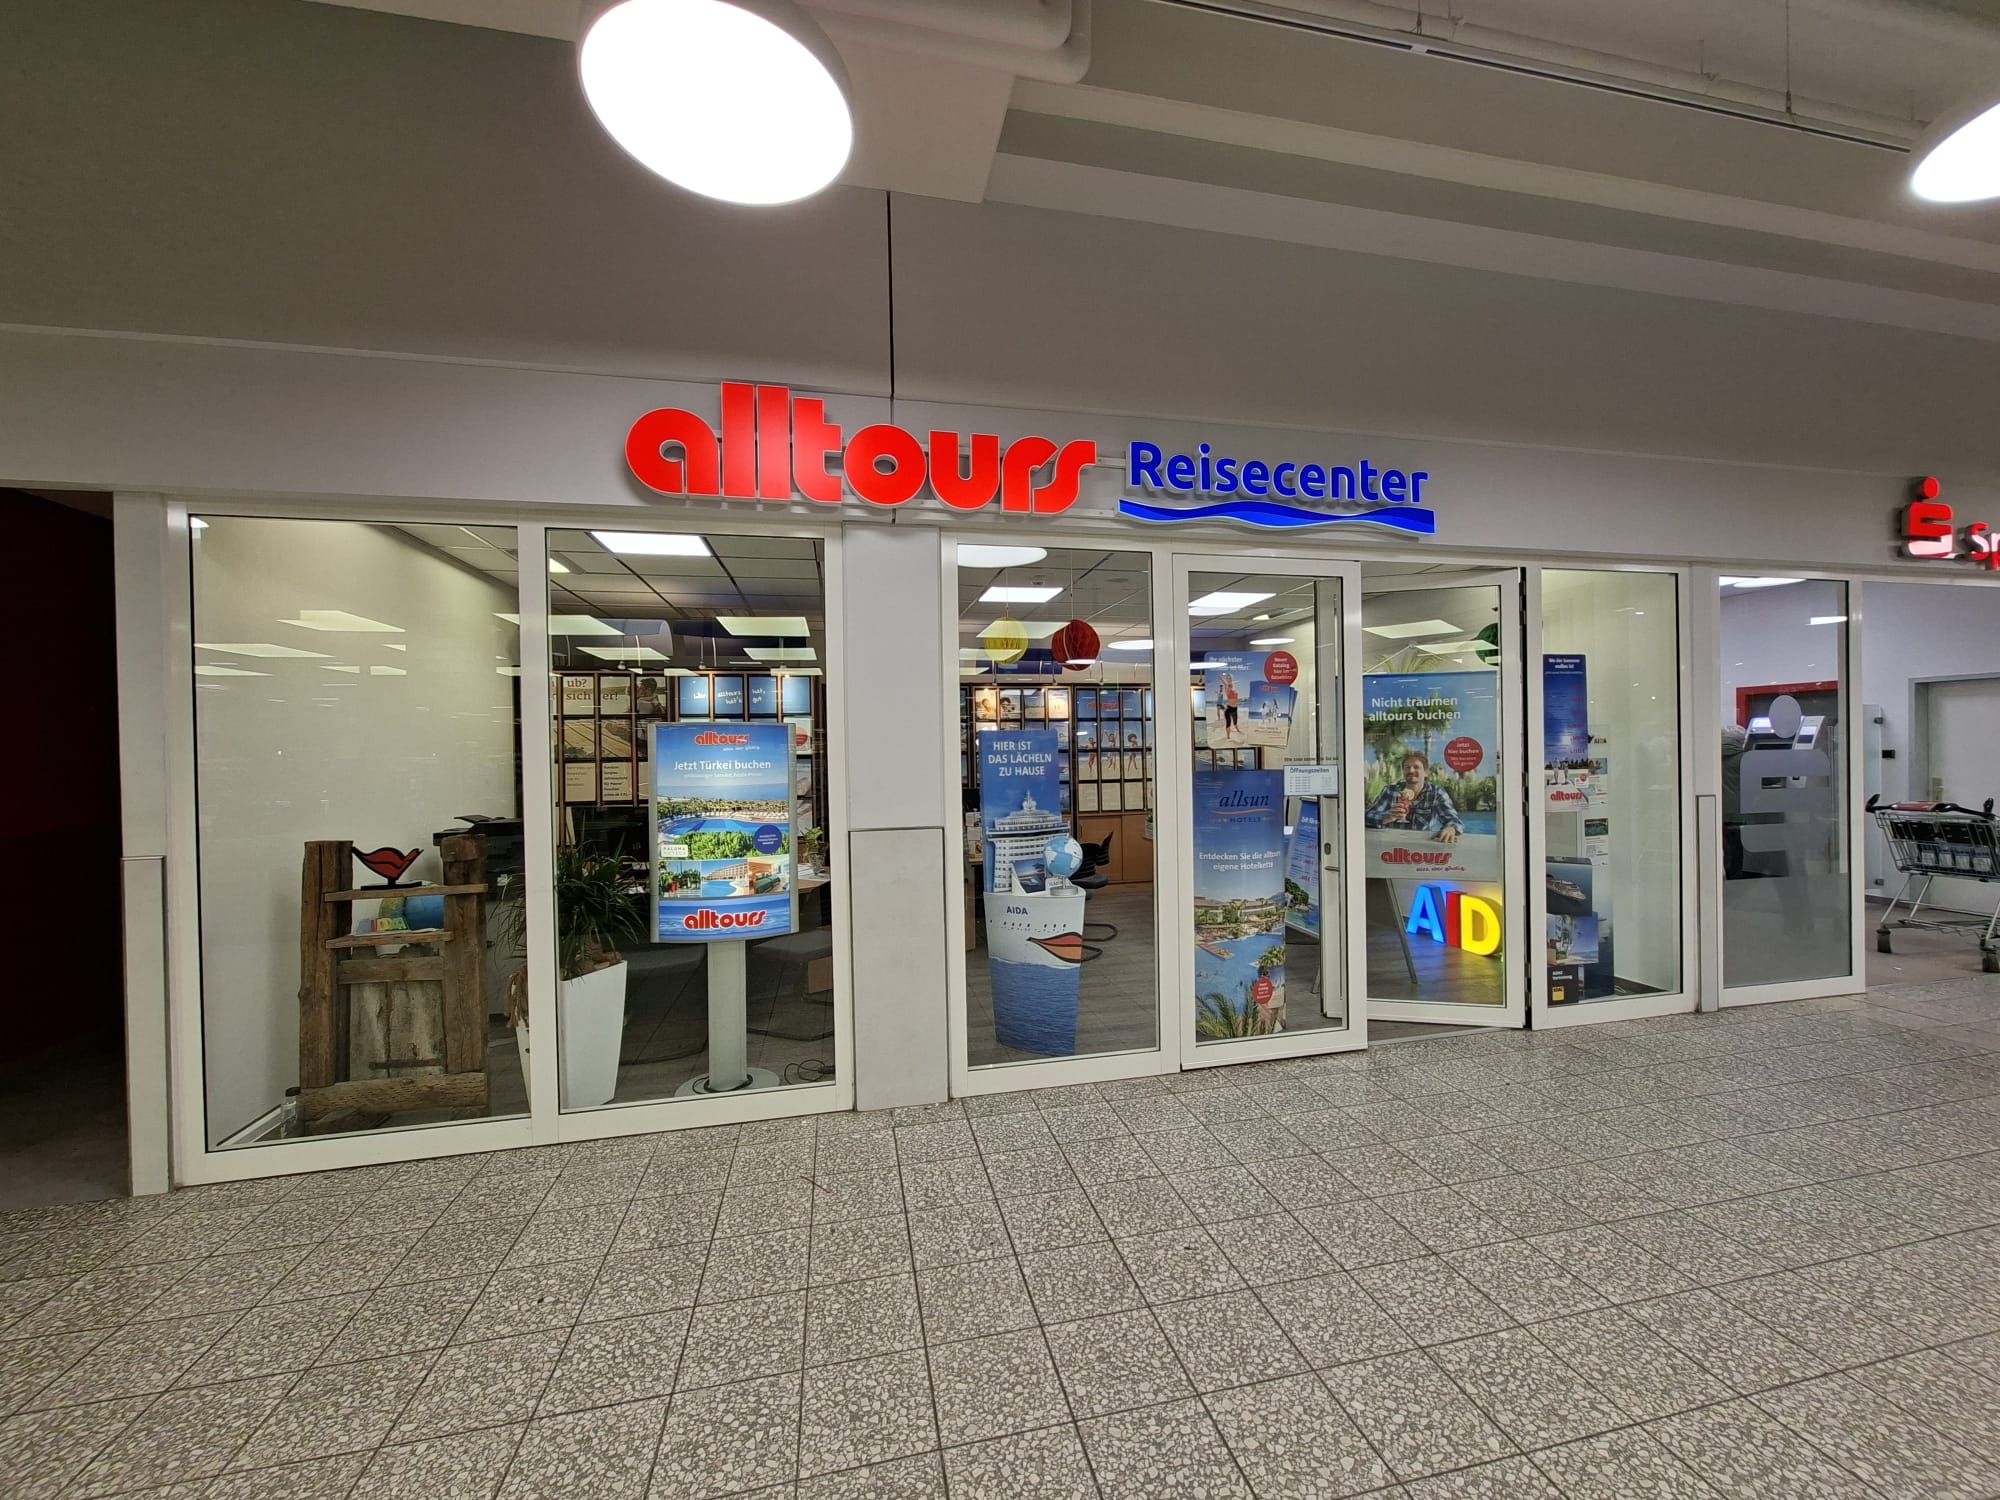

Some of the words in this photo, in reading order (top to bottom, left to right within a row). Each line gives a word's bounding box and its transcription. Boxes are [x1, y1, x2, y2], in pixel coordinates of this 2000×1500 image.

[625, 381, 1097, 515] alltours
[1128, 438, 1430, 505] Reisecenter
[1372, 698, 1402, 708] Nicht
[1406, 696, 1458, 707] träumen
[1369, 710, 1414, 722] alltours
[1417, 710, 1461, 720] buchen
[993, 741, 1016, 751] HIER
[1018, 741, 1032, 750] IST
[988, 754, 1008, 764] DAS
[1010, 752, 1052, 764] LÄCHELN
[674, 760, 697, 771] Jetzt
[700, 760, 732, 770] Türkei
[735, 759, 771, 770] buchen
[998, 767, 1012, 777] ZU
[1015, 766, 1045, 776] HAUSE
[1219, 790, 1269, 807] allsun
[1200, 852, 1238, 861] Entdecken
[1252, 852, 1262, 860] die
[1380, 847, 1452, 865] alltours
[1213, 864, 1239, 872] eigene
[1007, 906, 1028, 916] AIDA
[683, 908, 768, 930] alltours
